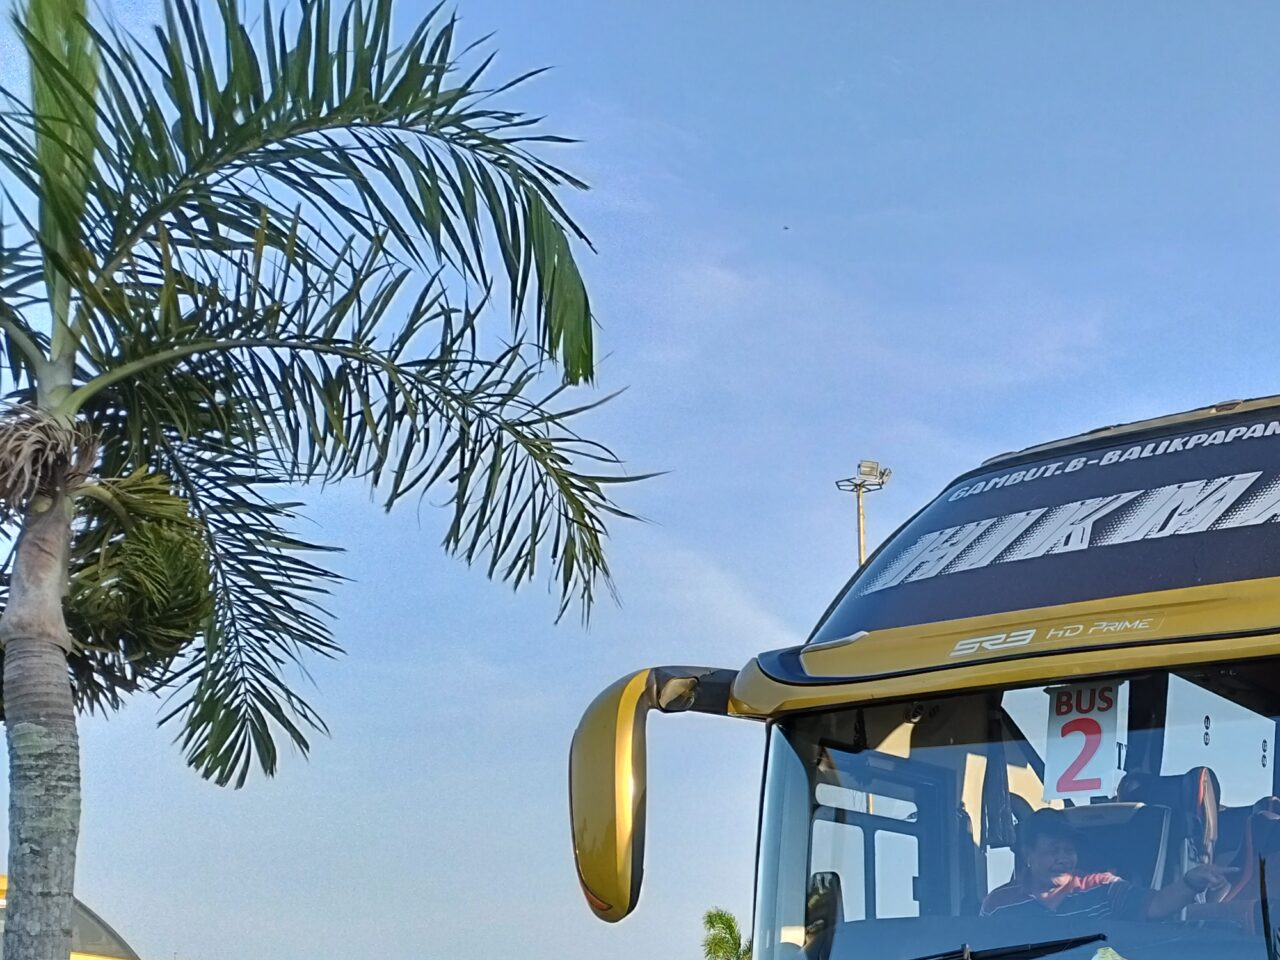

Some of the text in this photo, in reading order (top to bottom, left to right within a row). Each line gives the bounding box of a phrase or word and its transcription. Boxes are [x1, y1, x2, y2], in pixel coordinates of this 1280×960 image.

[1088, 618, 1154, 634] PRIME
[1055, 686, 1114, 716] BUS
[1056, 717, 1102, 793] 2
